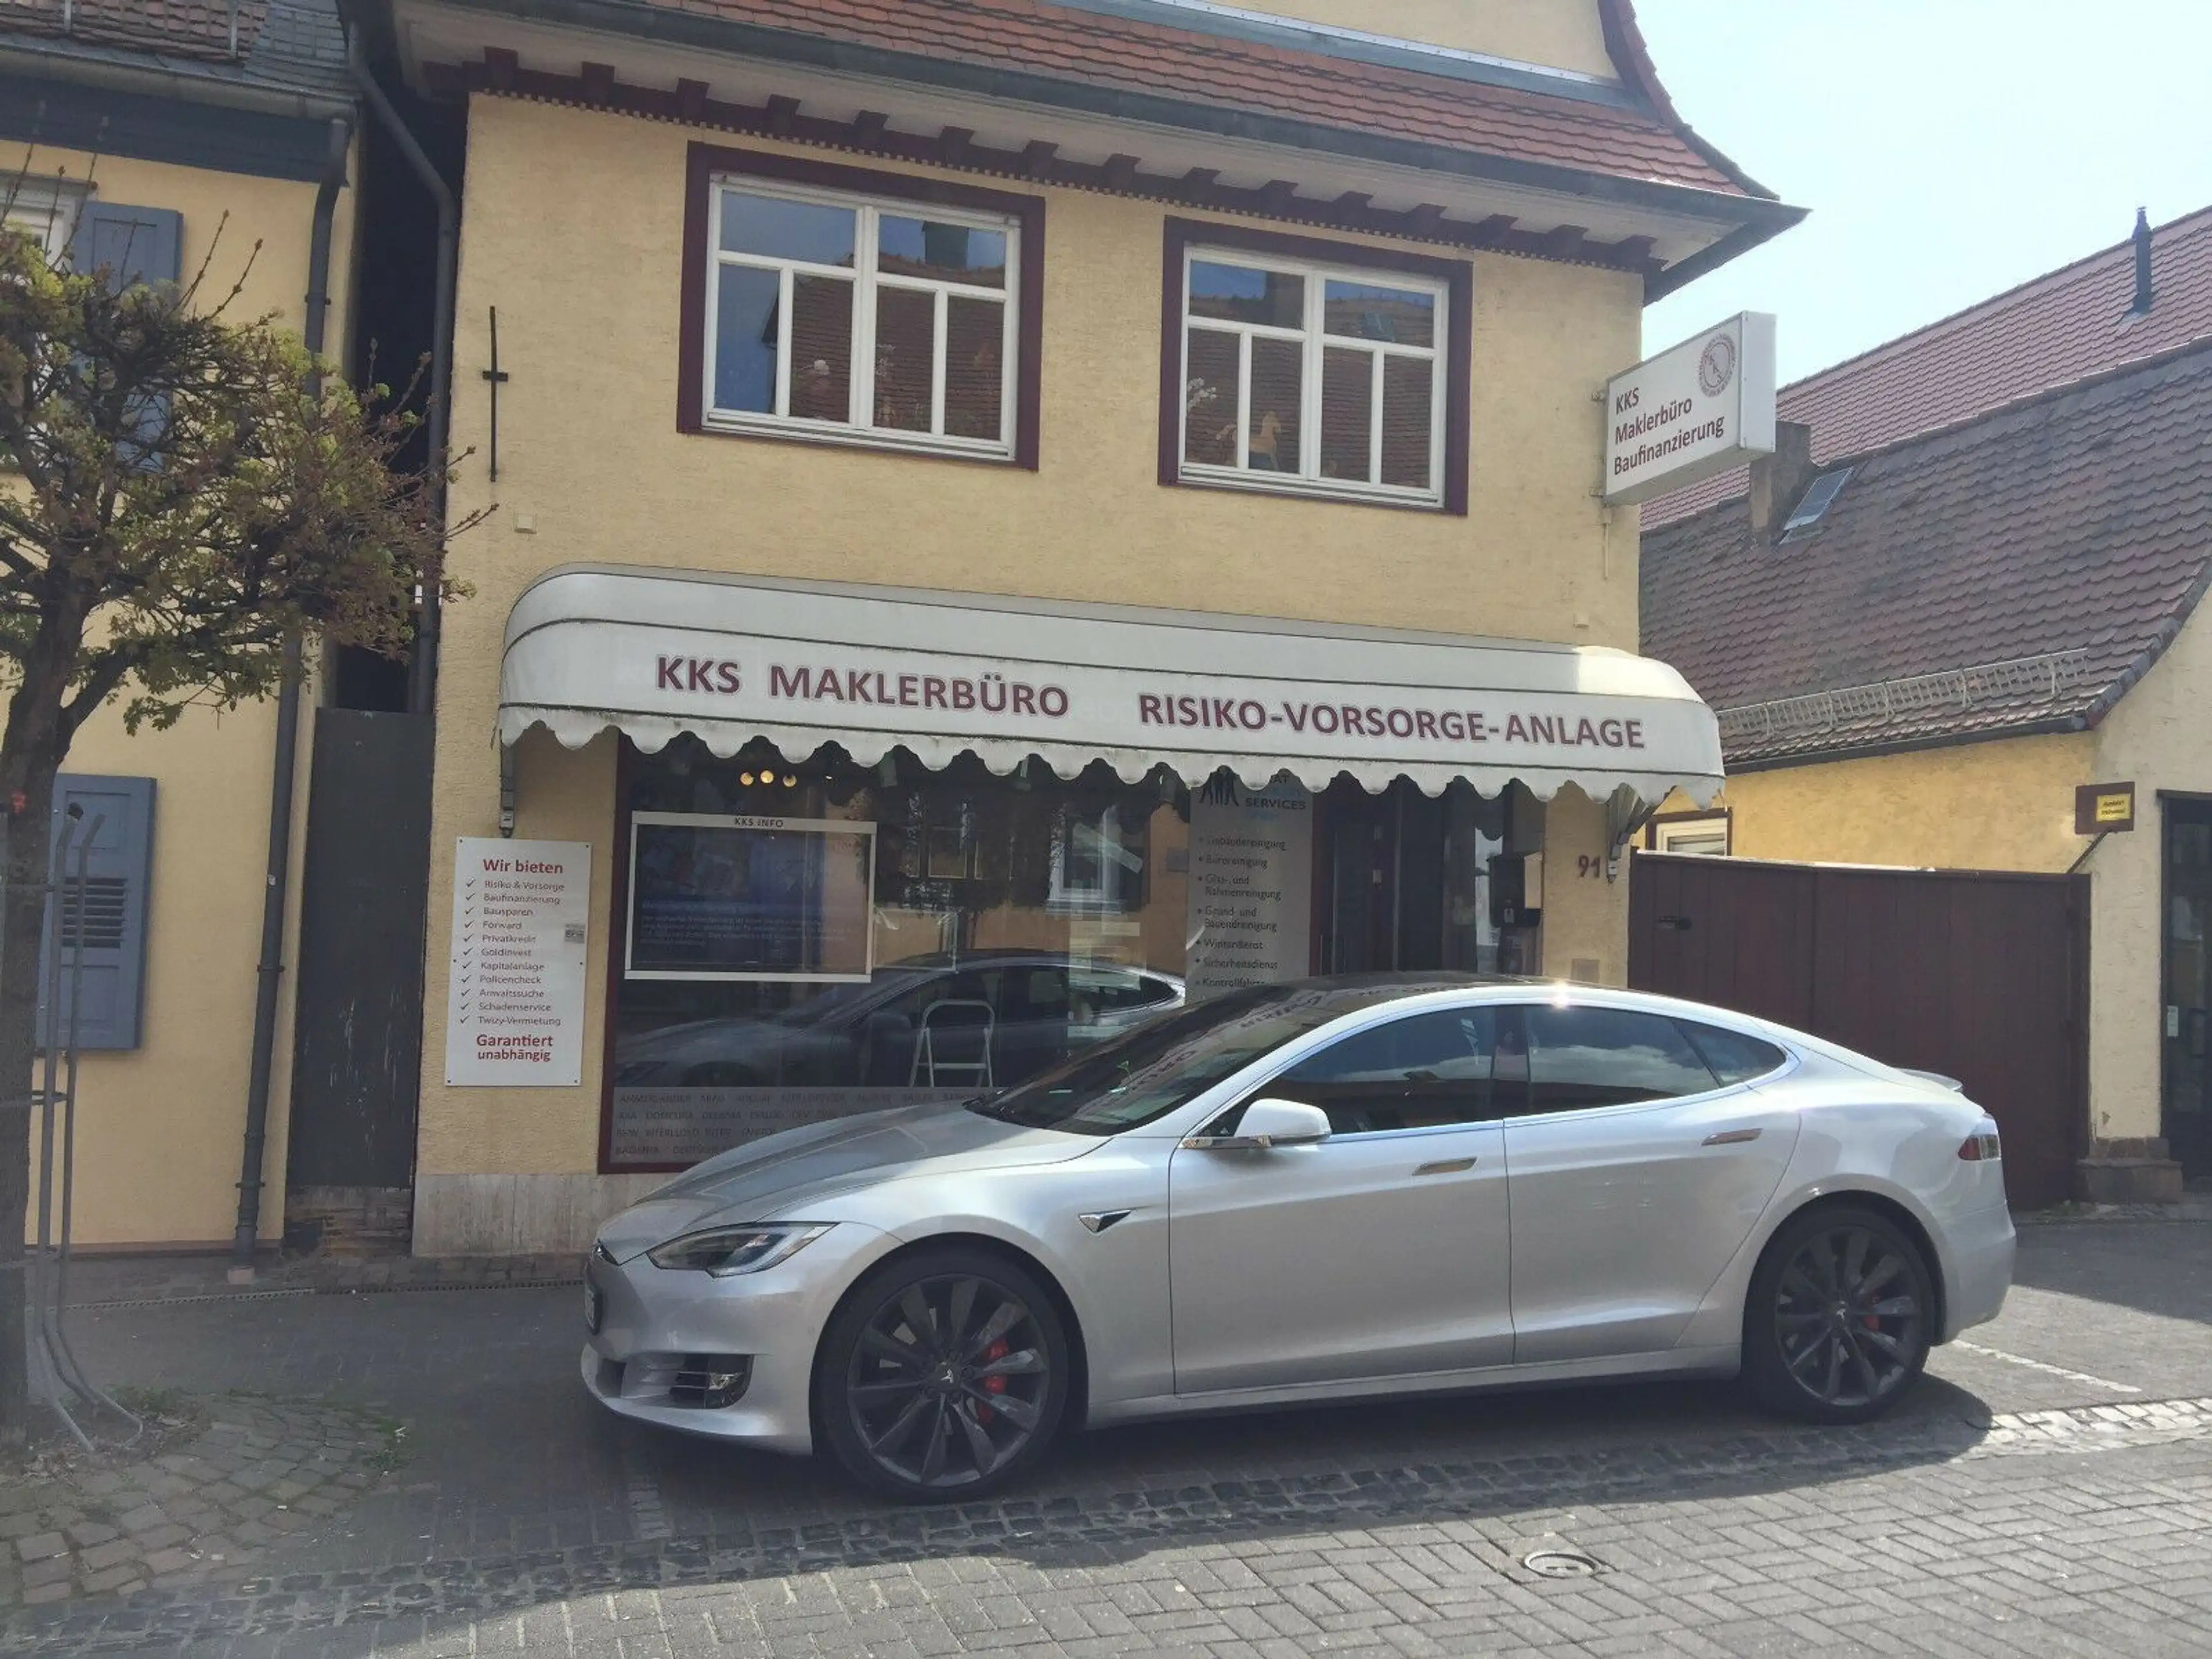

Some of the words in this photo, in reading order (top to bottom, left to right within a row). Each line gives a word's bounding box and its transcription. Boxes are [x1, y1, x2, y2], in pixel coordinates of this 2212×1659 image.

[1616, 387, 1639, 415] KKS
[1615, 397, 1692, 445] Maklerbüro
[1614, 416, 1725, 476] Baufinanzierung
[657, 656, 740, 693] KKS
[770, 665, 1069, 717] MAKLERBÜRO
[1139, 694, 1645, 749] RISIKO-VORSORGE-ANLAGE
[1245, 797, 1306, 810] SERVICES
[757, 819, 784, 828] INFO
[483, 858, 511, 872] Wir
[515, 859, 563, 874] bieten
[1578, 855, 1600, 878] 91
[484, 880, 510, 889] Risiko
[513, 881, 521, 889] &
[522, 882, 565, 892] Vorsorge
[483, 893, 561, 905] Baufinanzierung
[483, 907, 533, 917] Bausparen
[1239, 907, 1257, 917] und
[482, 921, 522, 930] Forward
[1204, 938, 1263, 950] Winterdienst
[481, 948, 532, 957] Goldinvest
[481, 962, 545, 973] Kapitalanlage
[1203, 958, 1278, 969] Sicherheitsdienst
[480, 975, 541, 984] Policencheck
[479, 989, 545, 998] Anwaltssuche
[478, 1002, 551, 1012] Schadenservice
[478, 1016, 561, 1027] Twizy-Vermietung
[476, 1034, 554, 1048] Garantiert
[478, 1049, 551, 1063] unabhängig
